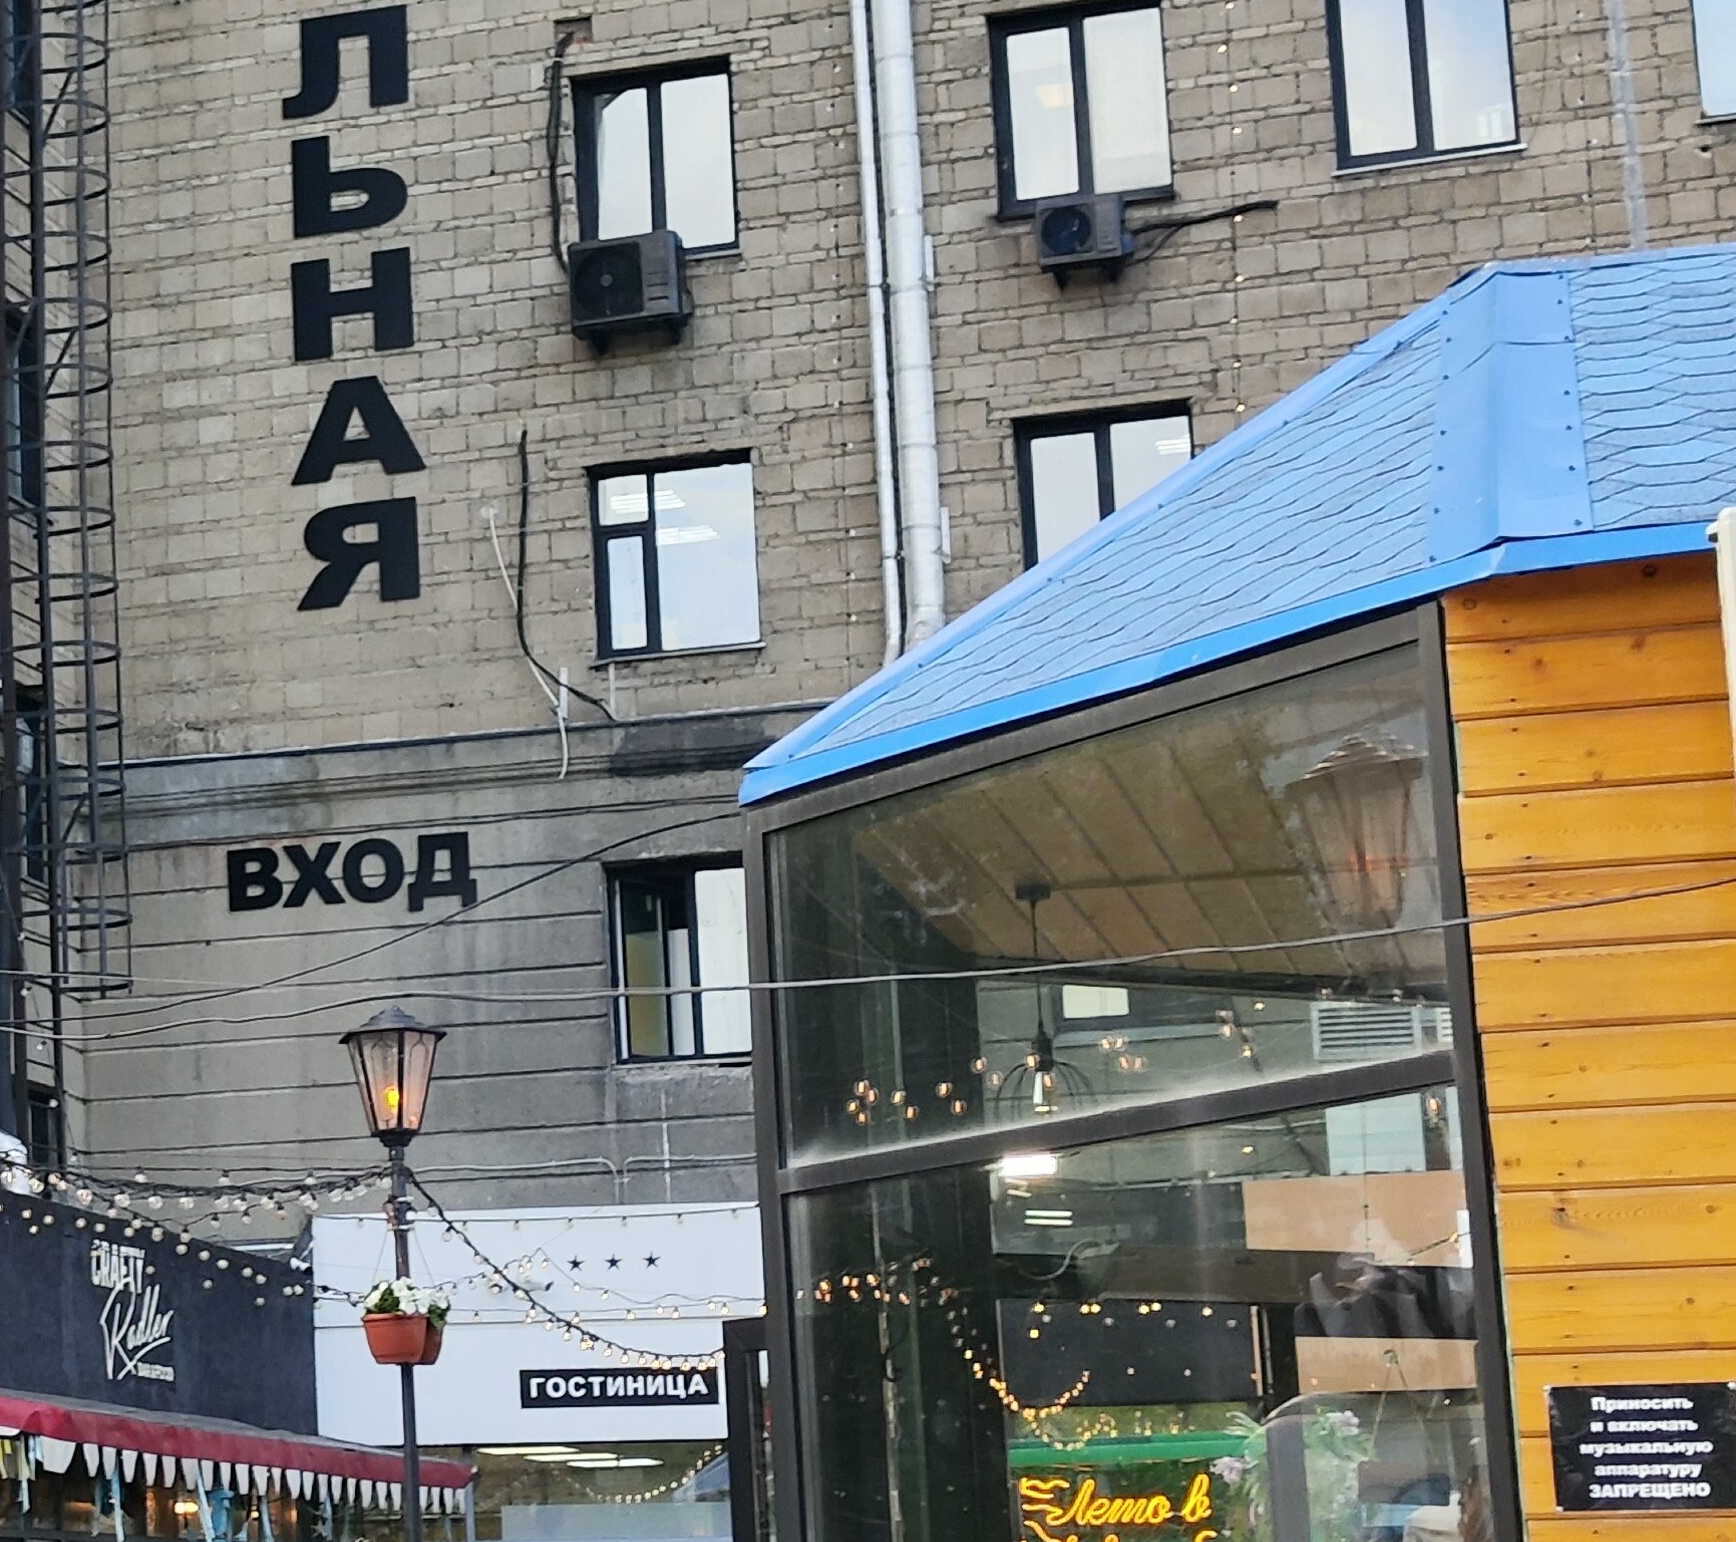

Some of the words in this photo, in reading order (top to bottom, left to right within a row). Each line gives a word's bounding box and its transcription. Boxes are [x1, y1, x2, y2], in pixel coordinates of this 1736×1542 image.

[226, 831, 478, 913] ВХОД
[528, 1372, 709, 1400] ГОСТИНИЦА
[1590, 1396, 1695, 1414] Приносить
[1590, 1421, 1605, 1433] и
[1606, 1419, 1699, 1433] включать
[1579, 1440, 1714, 1458] музыкальную
[1594, 1463, 1703, 1479] аппаратуру
[1019, 1477, 1174, 1527] Лето
[1181, 1473, 1212, 1524] в
[1588, 1482, 1712, 1500] ЗАПРЕЩЕНО
